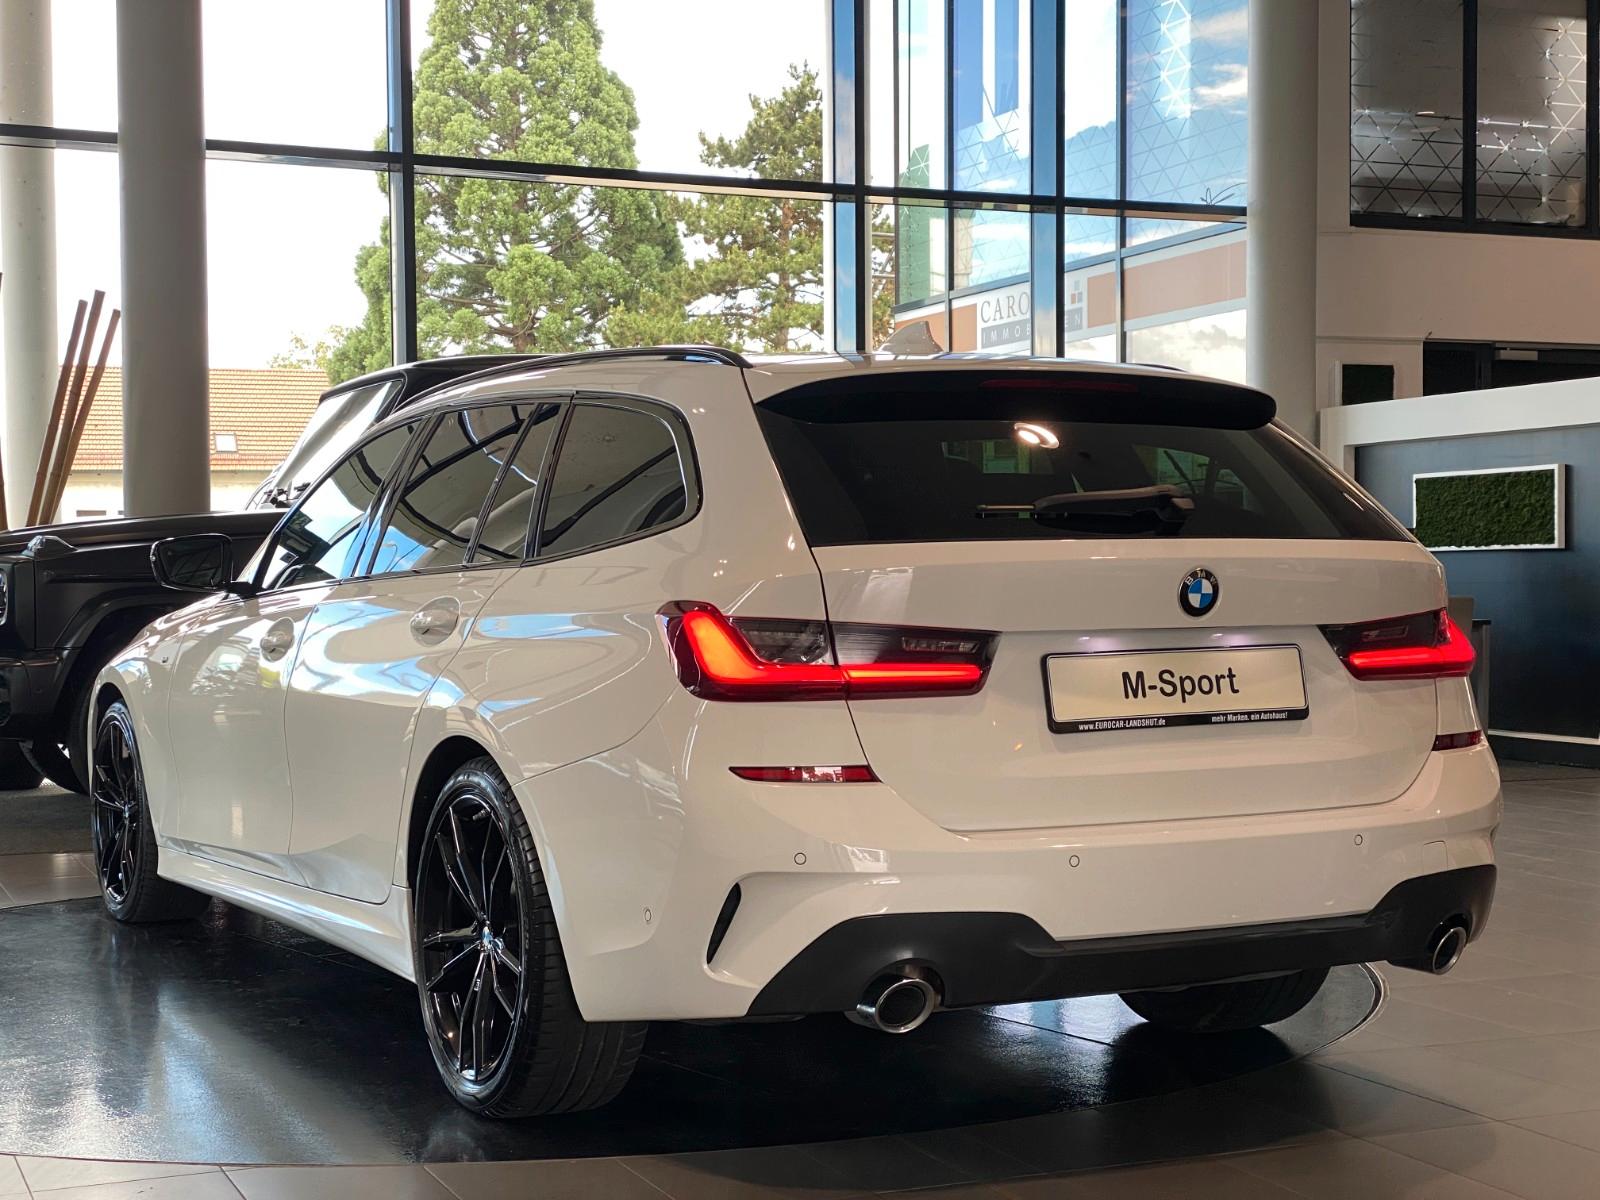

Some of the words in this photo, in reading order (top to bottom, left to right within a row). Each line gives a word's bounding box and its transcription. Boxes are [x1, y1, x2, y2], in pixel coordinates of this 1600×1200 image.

[1121, 667, 1240, 703] M-Sport
[1211, 714, 1226, 723] mehr
[1260, 711, 1288, 720] Autohaus!
[1078, 718, 1166, 731] www.EUROCAR-LANDSHUT.de
